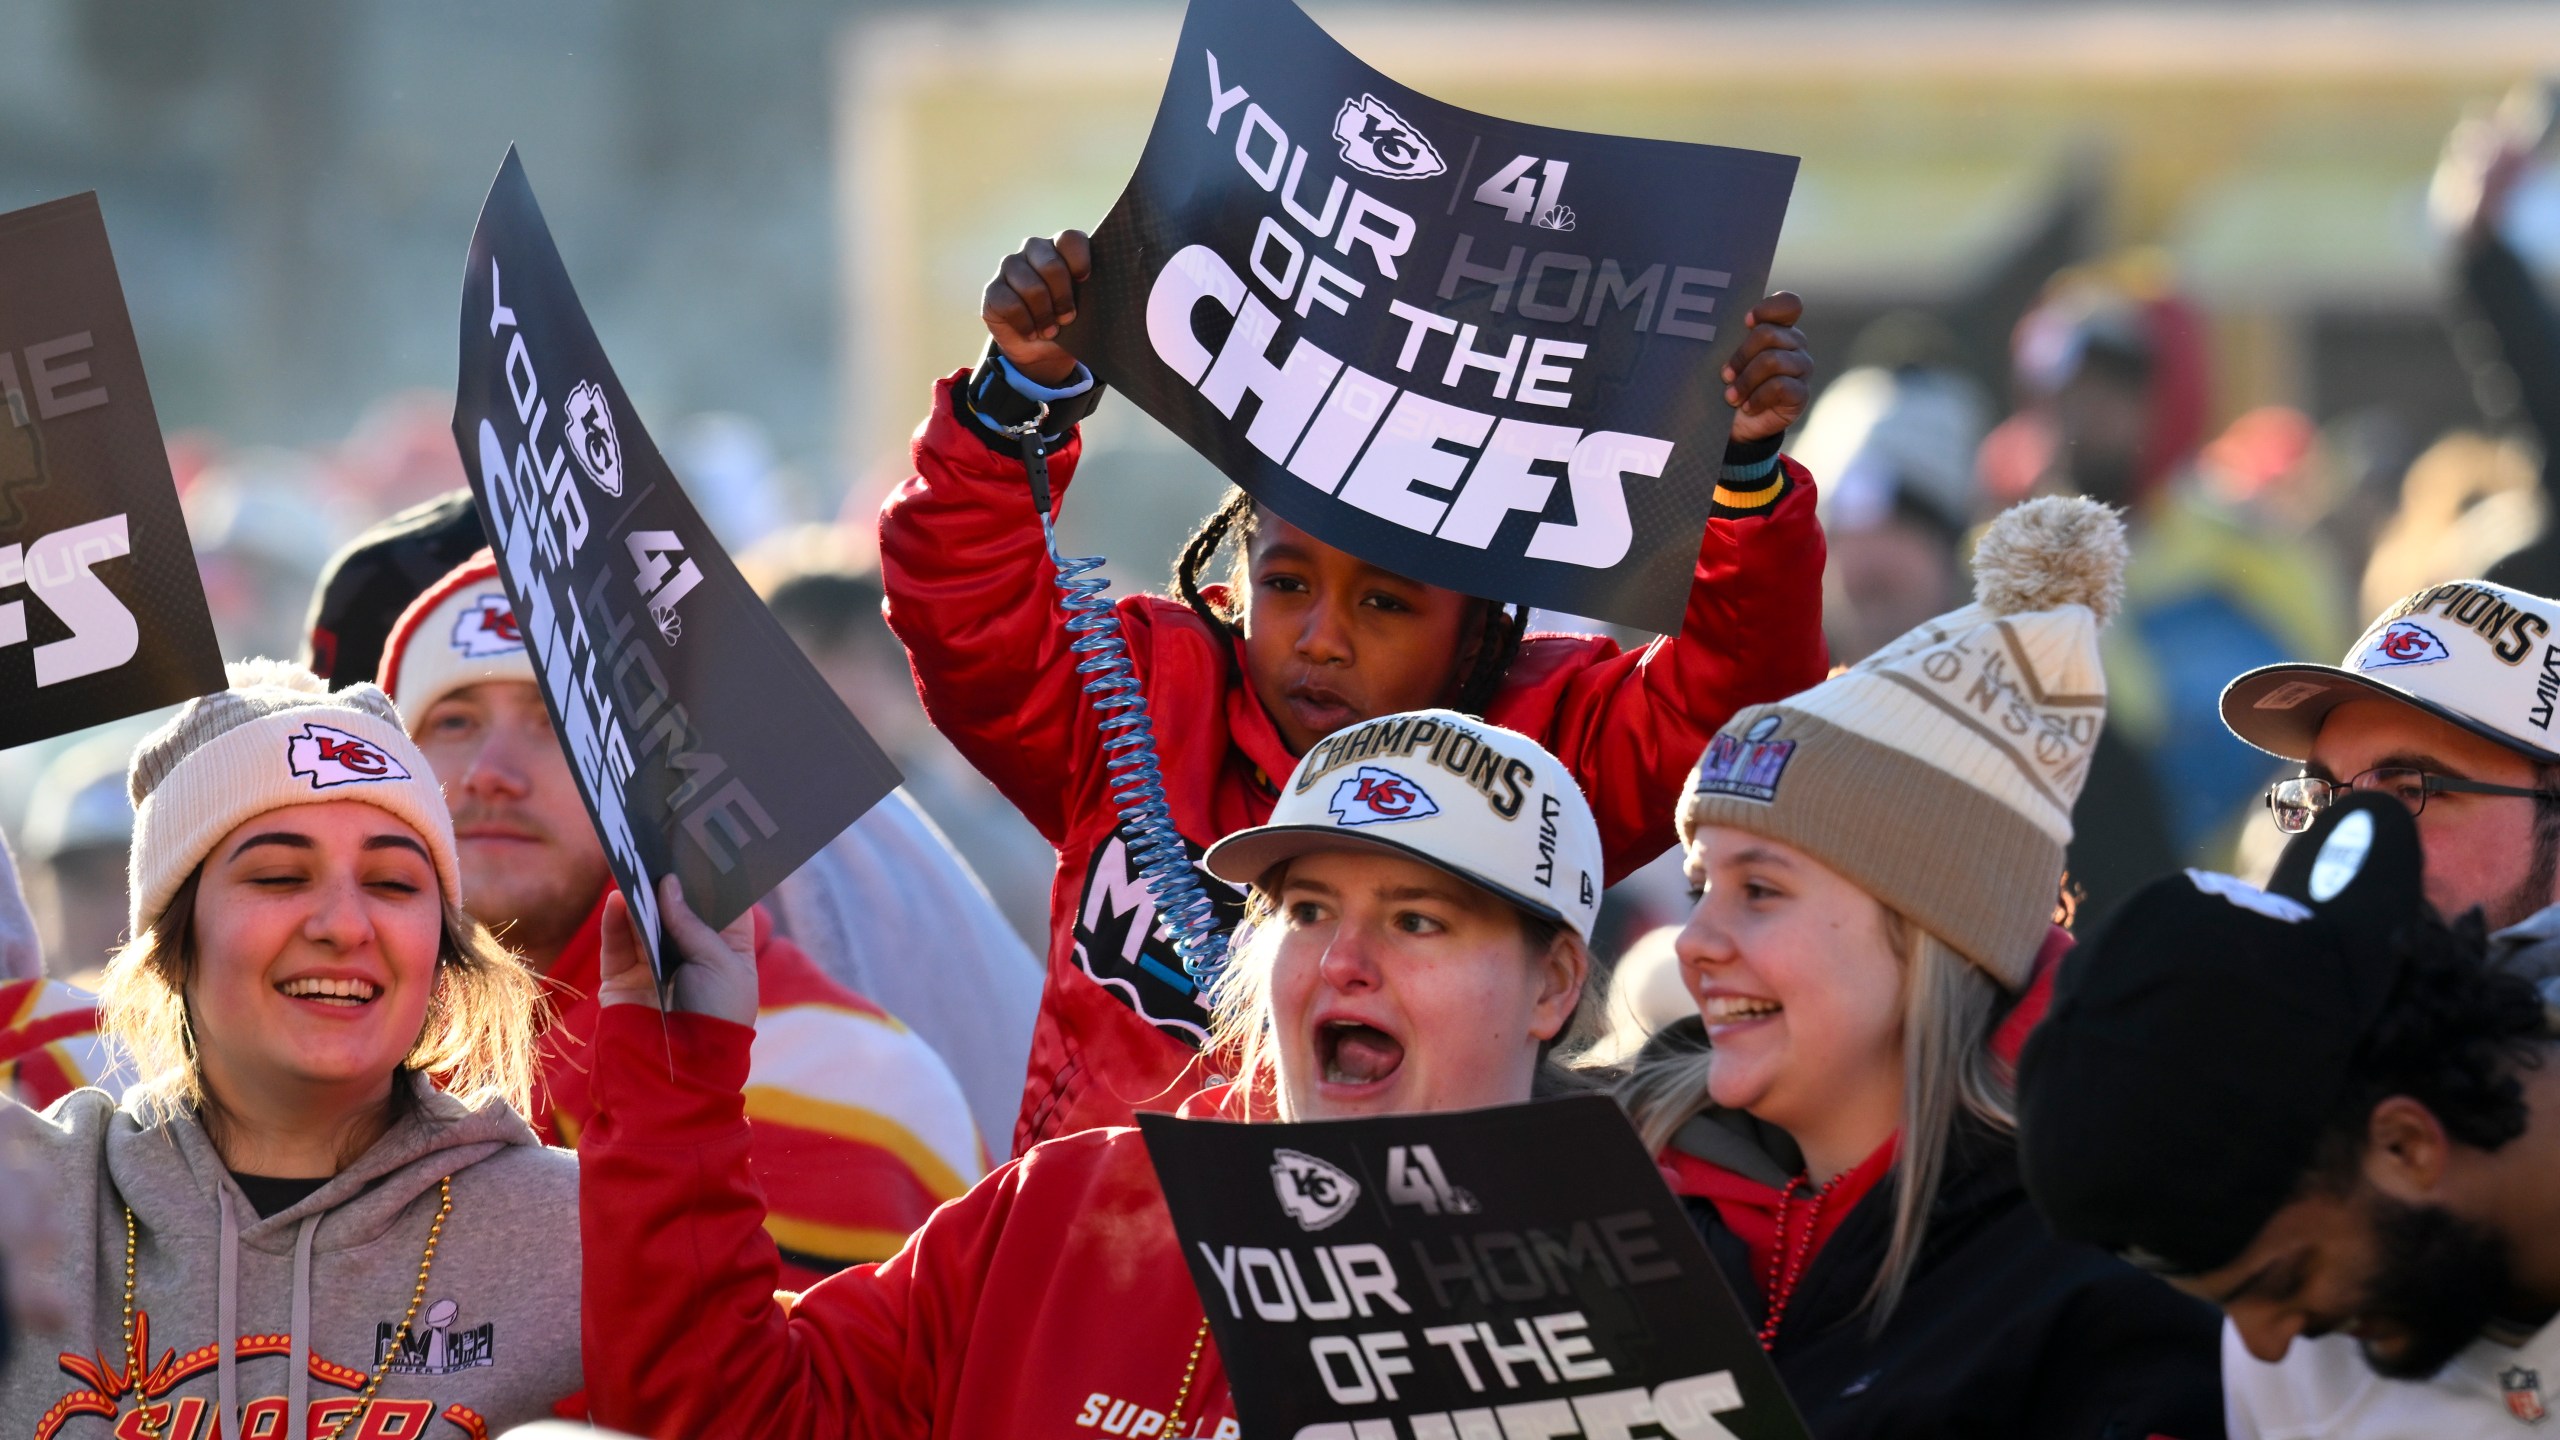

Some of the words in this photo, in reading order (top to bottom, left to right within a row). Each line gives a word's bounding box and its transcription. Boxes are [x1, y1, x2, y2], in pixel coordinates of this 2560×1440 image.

[1205, 48, 1416, 280] YOUR
[1437, 234, 1731, 342] HOME
[1474, 155, 1570, 227] 41
[1250, 216, 1365, 318] OF
[1388, 299, 1588, 408] THE
[1146, 244, 1674, 569] CHIEFS
[490, 255, 589, 569] YOUR
[586, 563, 780, 876] HOME
[515, 442, 561, 573] OF
[567, 585, 635, 790] THE
[624, 530, 704, 610] 41
[2377, 631, 2431, 660] KC
[479, 418, 662, 980] CHIEFS
[315, 737, 388, 775] KC
[1295, 719, 1535, 822] CHAMPIONS
[1353, 778, 1416, 815] KC
[1386, 1144, 1455, 1215] 41
[1199, 1242, 1412, 1322] YOUR
[1411, 1210, 1682, 1308] HOME
[1310, 1332, 1414, 1405] OF
[1424, 1311, 1615, 1392] THE
